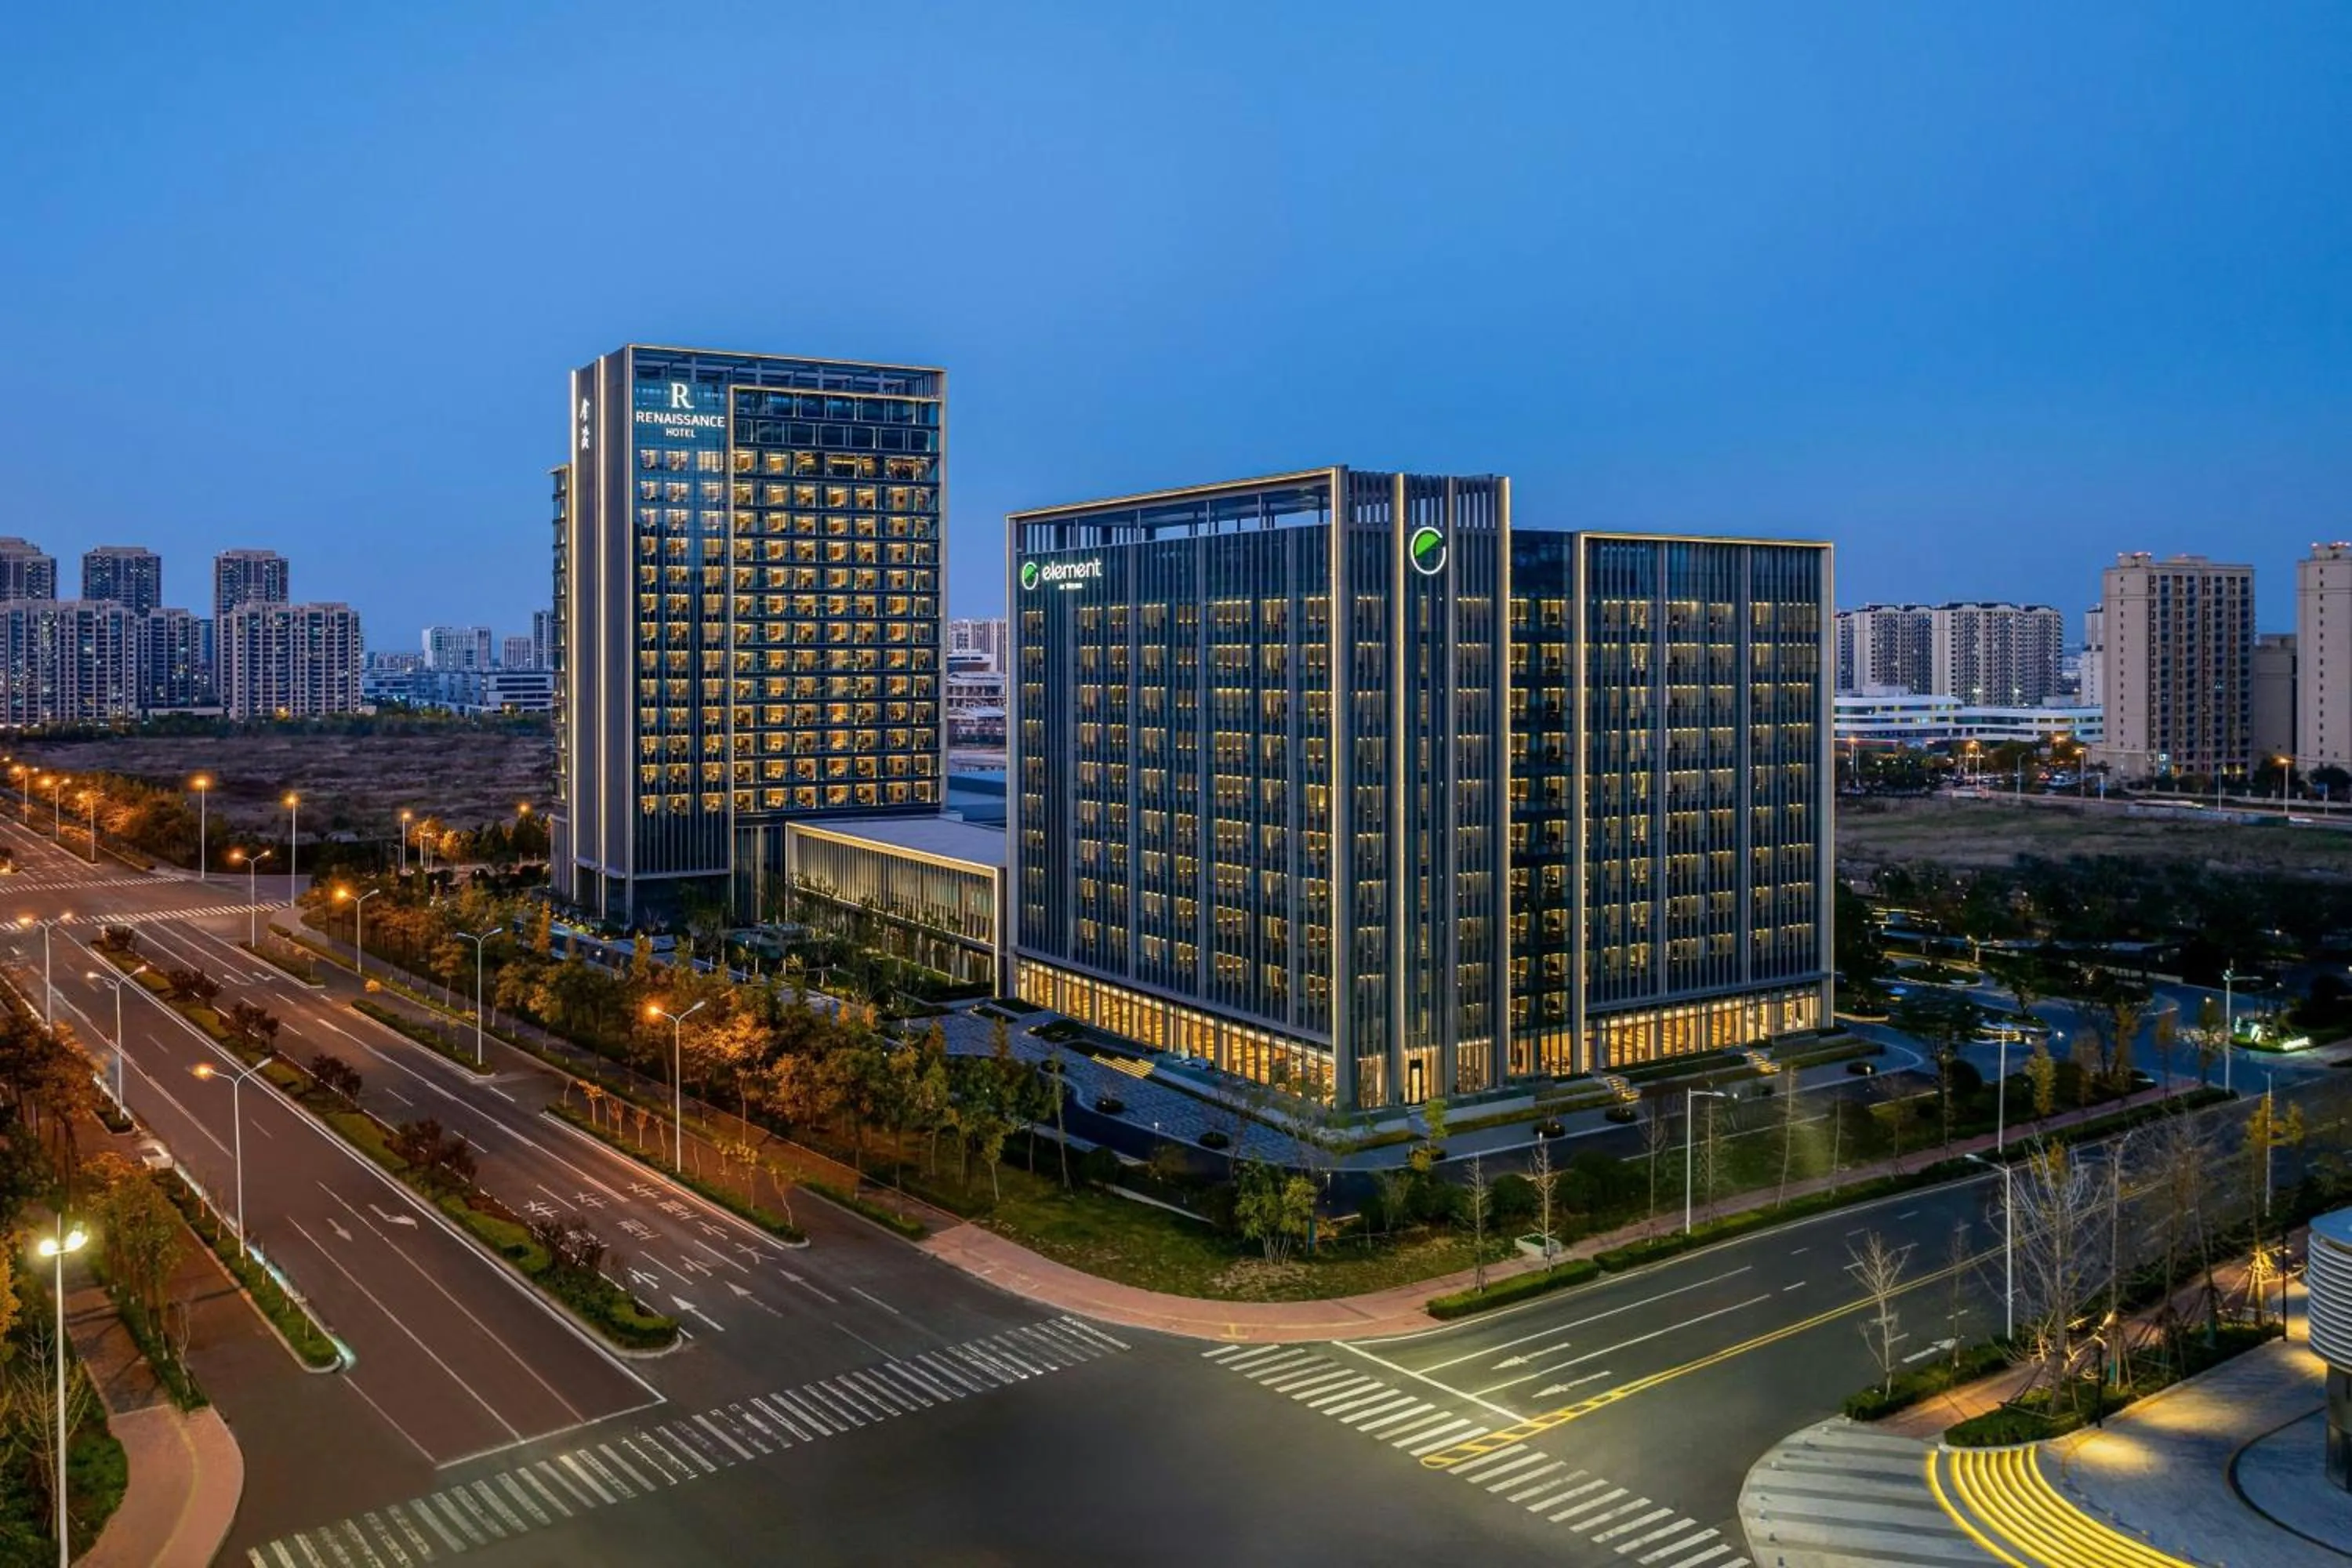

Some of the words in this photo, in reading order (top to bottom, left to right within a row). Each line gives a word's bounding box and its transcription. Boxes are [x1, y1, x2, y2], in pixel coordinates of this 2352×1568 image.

[671, 382, 695, 408] R
[636, 410, 725, 427] RENAISSANCE
[666, 428, 696, 438] HOTEL
[1042, 557, 1102, 580] element
